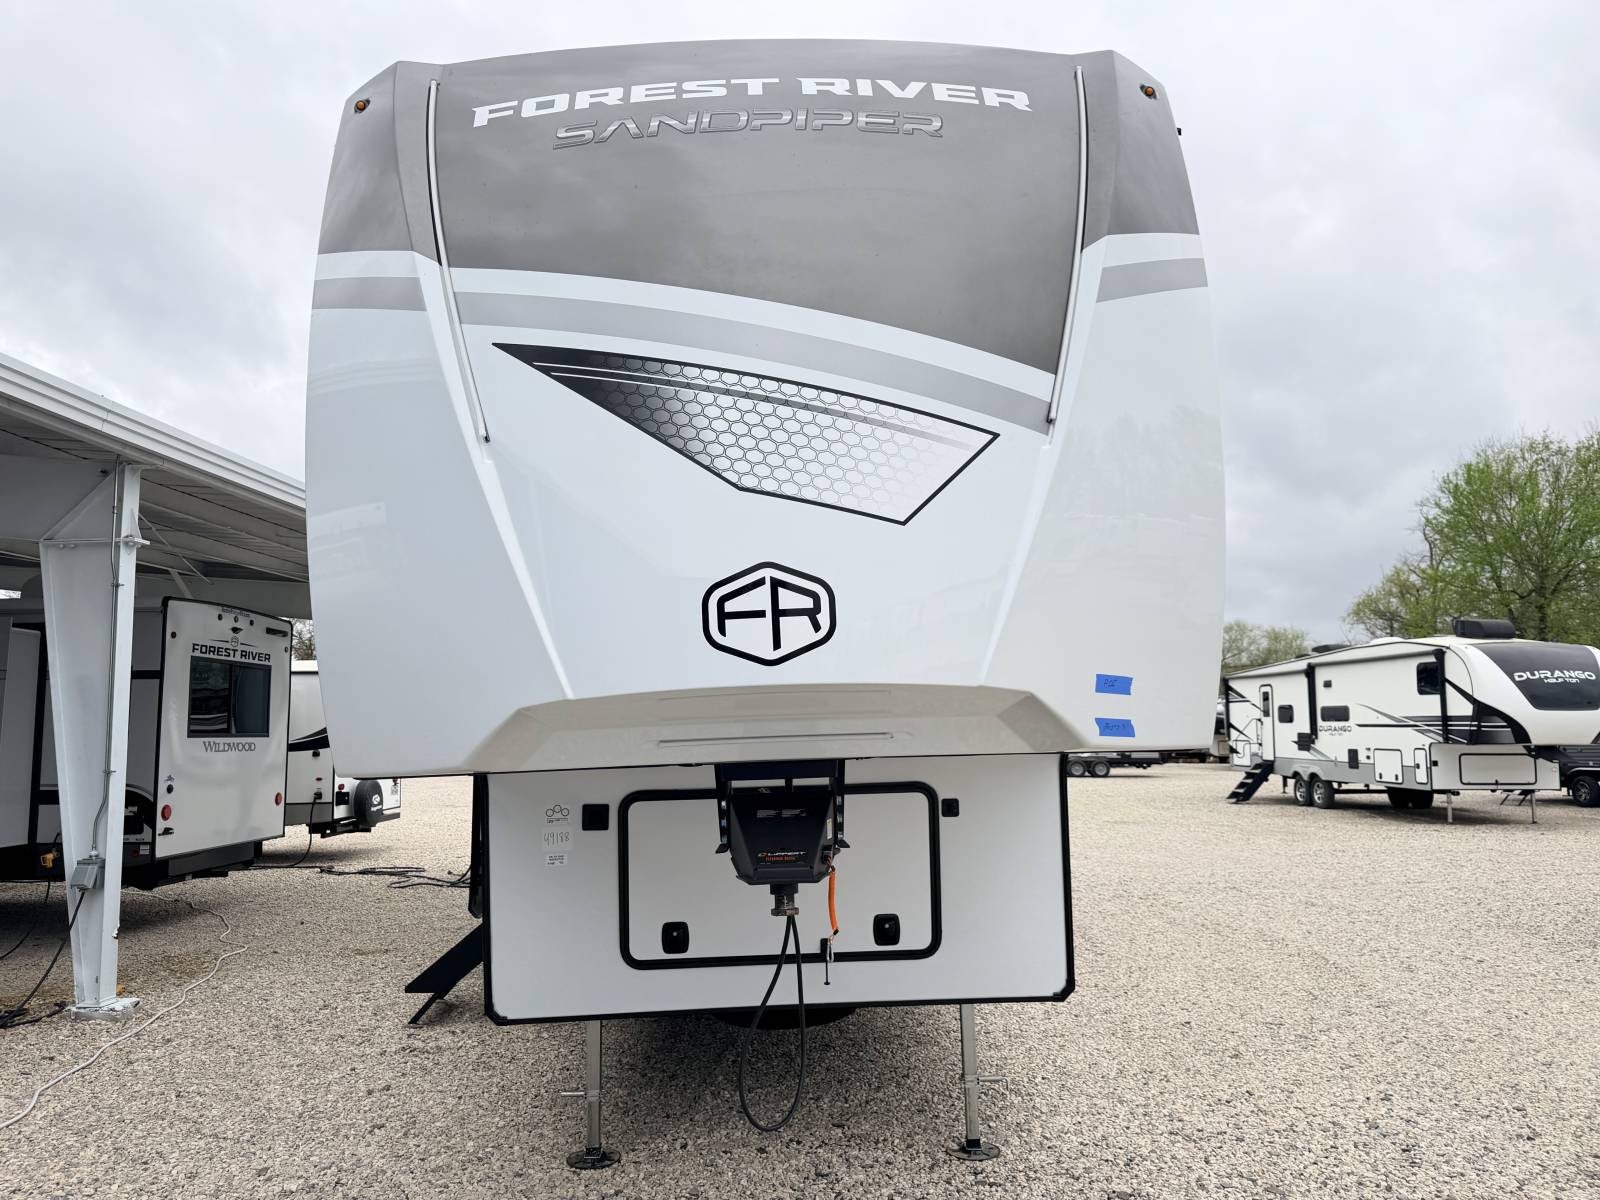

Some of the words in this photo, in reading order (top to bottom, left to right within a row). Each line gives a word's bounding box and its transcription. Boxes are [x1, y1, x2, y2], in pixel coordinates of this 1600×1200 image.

[472, 78, 779, 128] FOREST
[796, 77, 1033, 112] RIVER
[553, 107, 943, 150] SANDPIPER
[192, 643, 238, 658] FOREST
[240, 650, 271, 662] RIVER
[1513, 670, 1596, 681] DURANGO
